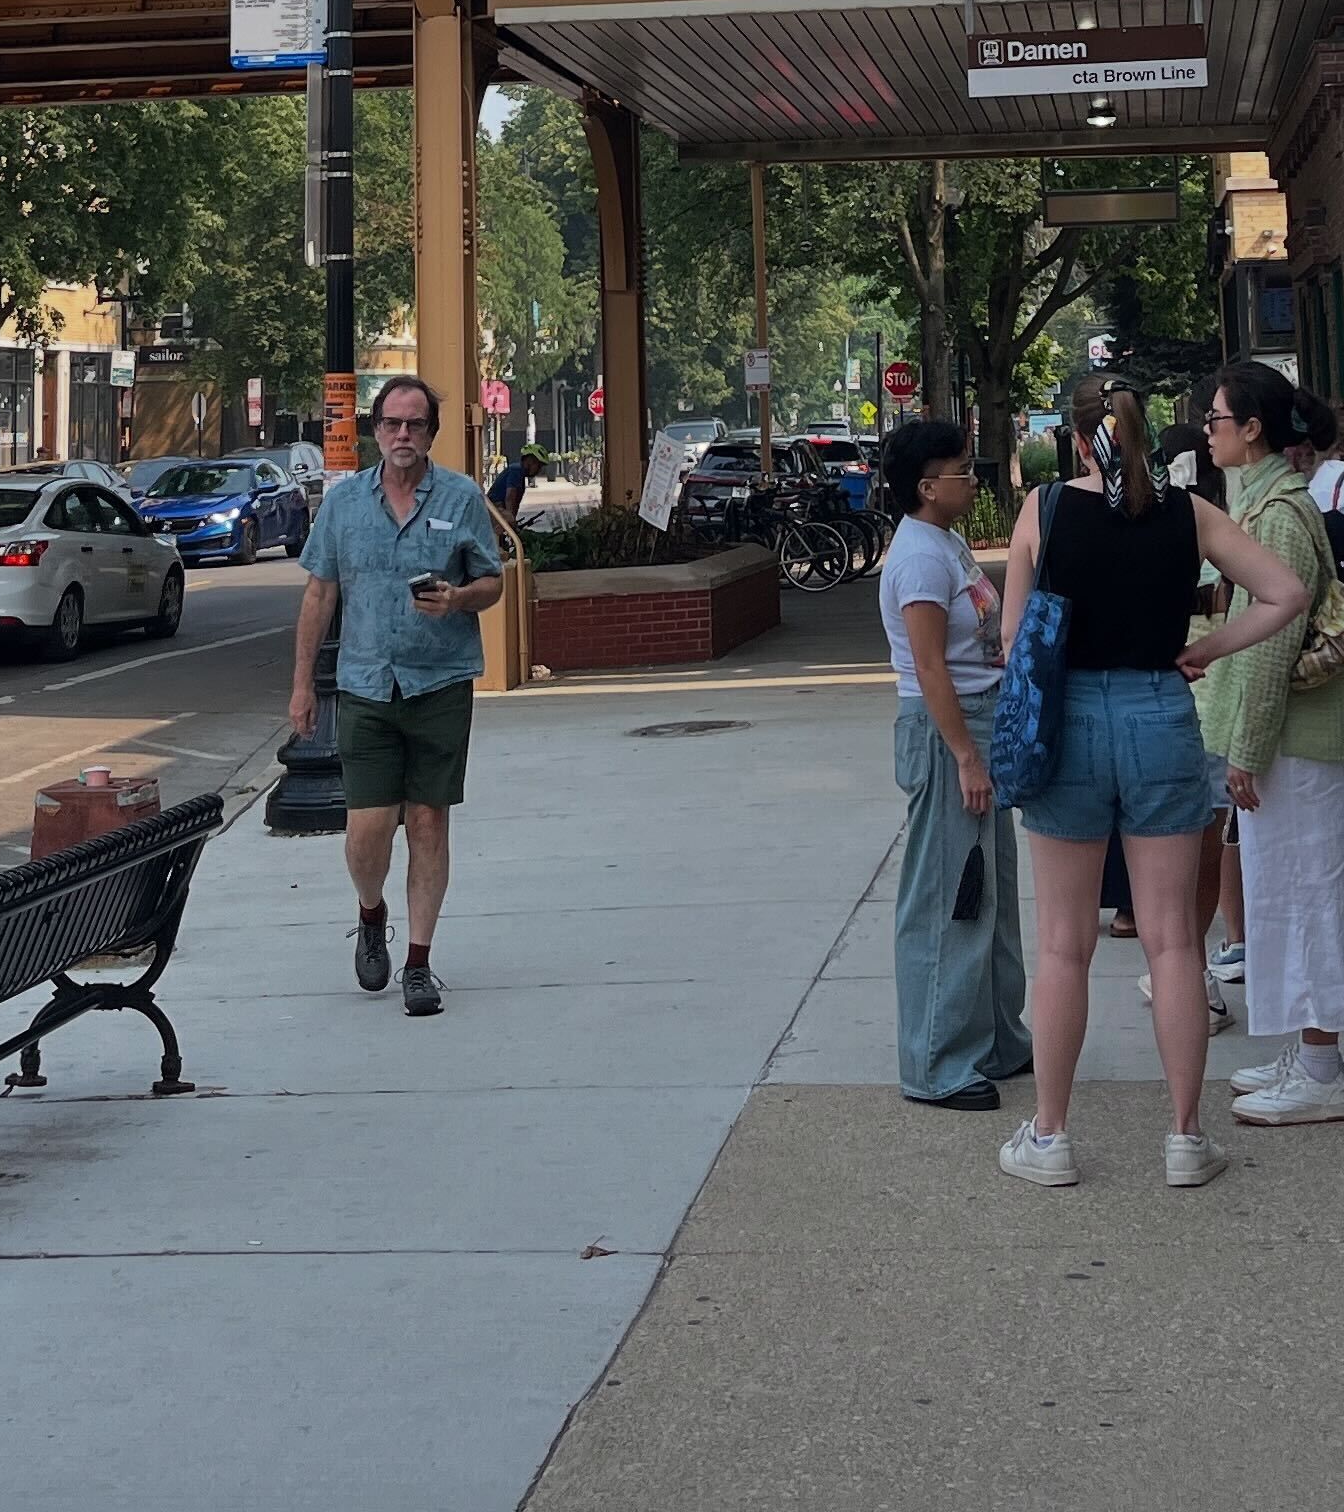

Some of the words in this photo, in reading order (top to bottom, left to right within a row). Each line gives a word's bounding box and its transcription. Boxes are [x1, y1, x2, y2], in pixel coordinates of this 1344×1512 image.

[1007, 42, 1087, 62] Damen
[1072, 71, 1099, 85] cta
[1104, 70, 1156, 83] Brown
[1161, 66, 1196, 80] Line
[590, 397, 604, 409] ST
